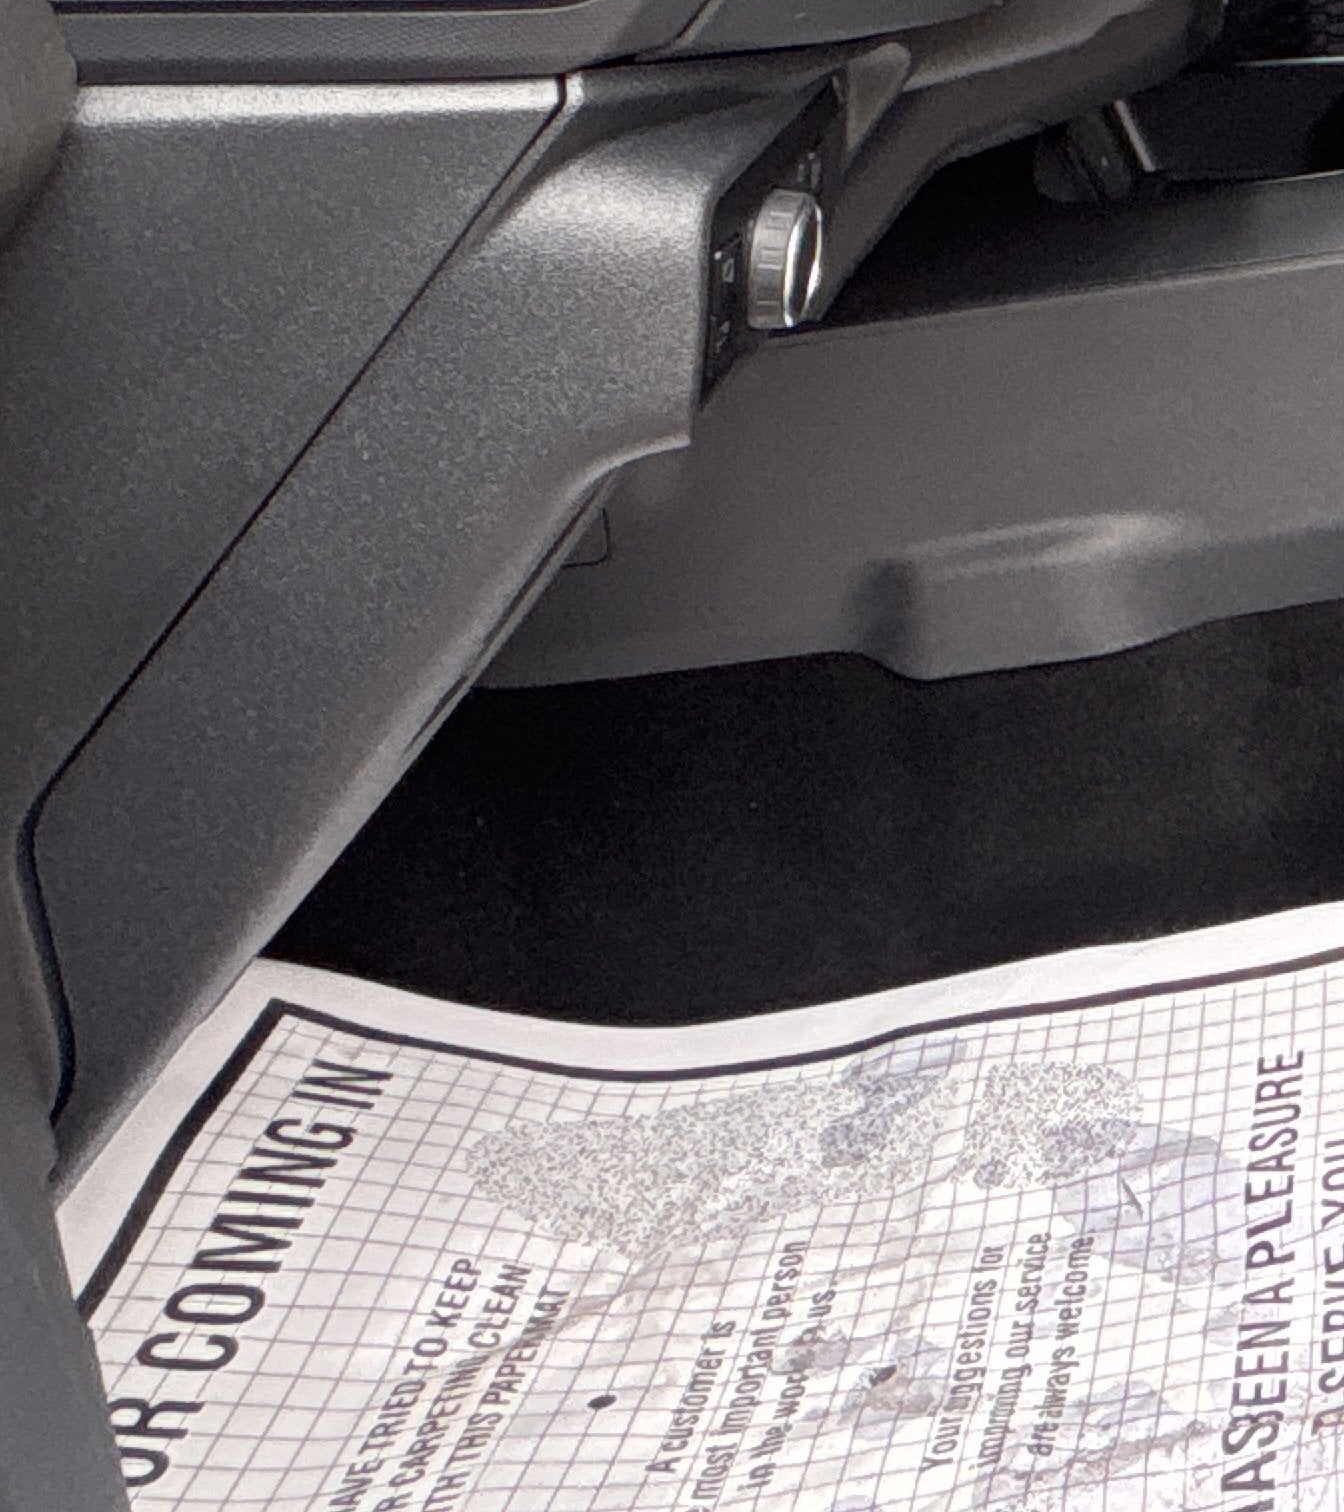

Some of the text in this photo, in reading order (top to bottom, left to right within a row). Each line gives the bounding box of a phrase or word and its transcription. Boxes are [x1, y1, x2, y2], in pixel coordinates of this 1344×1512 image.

[1244, 1048, 1305, 1268] PLEASURE
[137, 1118, 357, 1372] COMING
[292, 1058, 394, 1110] IN
[467, 1263, 532, 1349] CLEAN
[762, 1240, 810, 1321] person
[1015, 1231, 1052, 1313] service
[1242, 1278, 1294, 1304] A
[919, 1416, 964, 1472] Your
[971, 1245, 1004, 1273] for
[1005, 1320, 1034, 1359] our
[327, 1258, 482, 1512] AVE TRIED TO KEEP
[645, 1320, 737, 1474] A customer is
[709, 1326, 787, 1437] important
[1034, 1346, 1080, 1419] always
[445, 1412, 503, 1472] THIS
[691, 1441, 740, 1500] most
[1027, 1421, 1060, 1457] are
